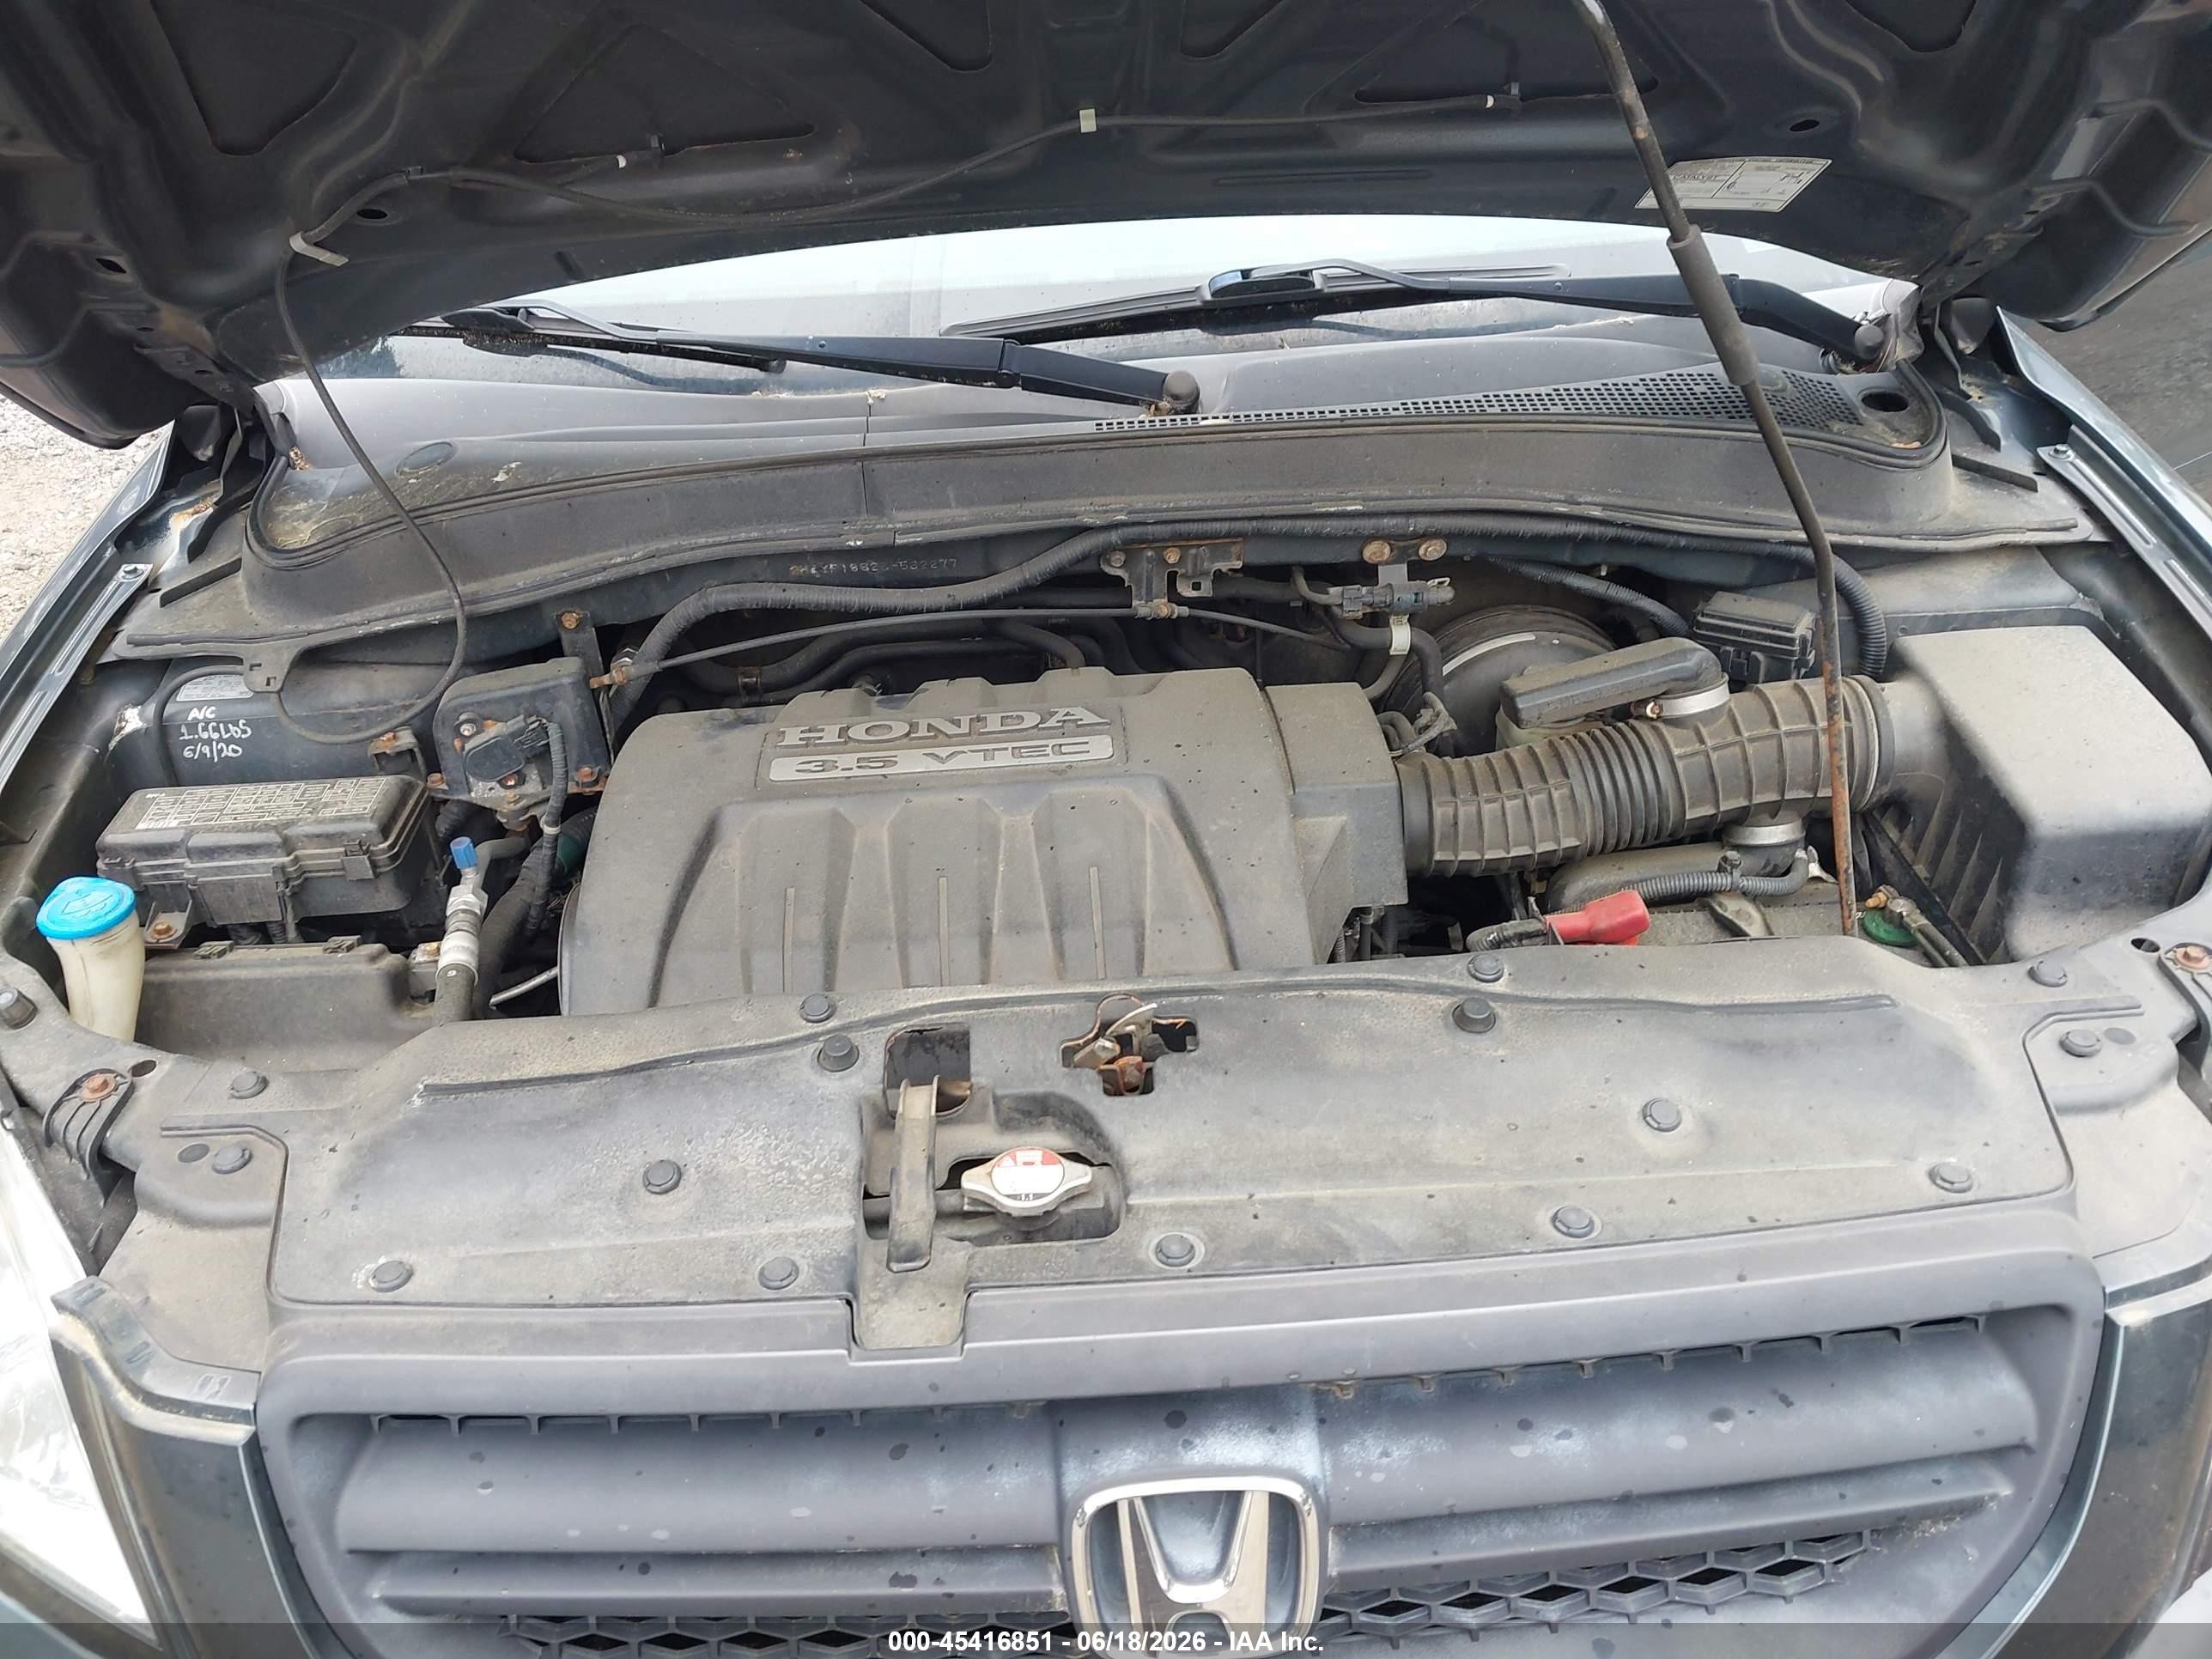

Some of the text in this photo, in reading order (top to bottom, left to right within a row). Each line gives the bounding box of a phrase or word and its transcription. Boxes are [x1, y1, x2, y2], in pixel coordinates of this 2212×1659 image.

[777, 707, 1110, 748] HONDA
[183, 740, 243, 763] 6/9/20
[794, 740, 1091, 774] 3.5 VTEC
